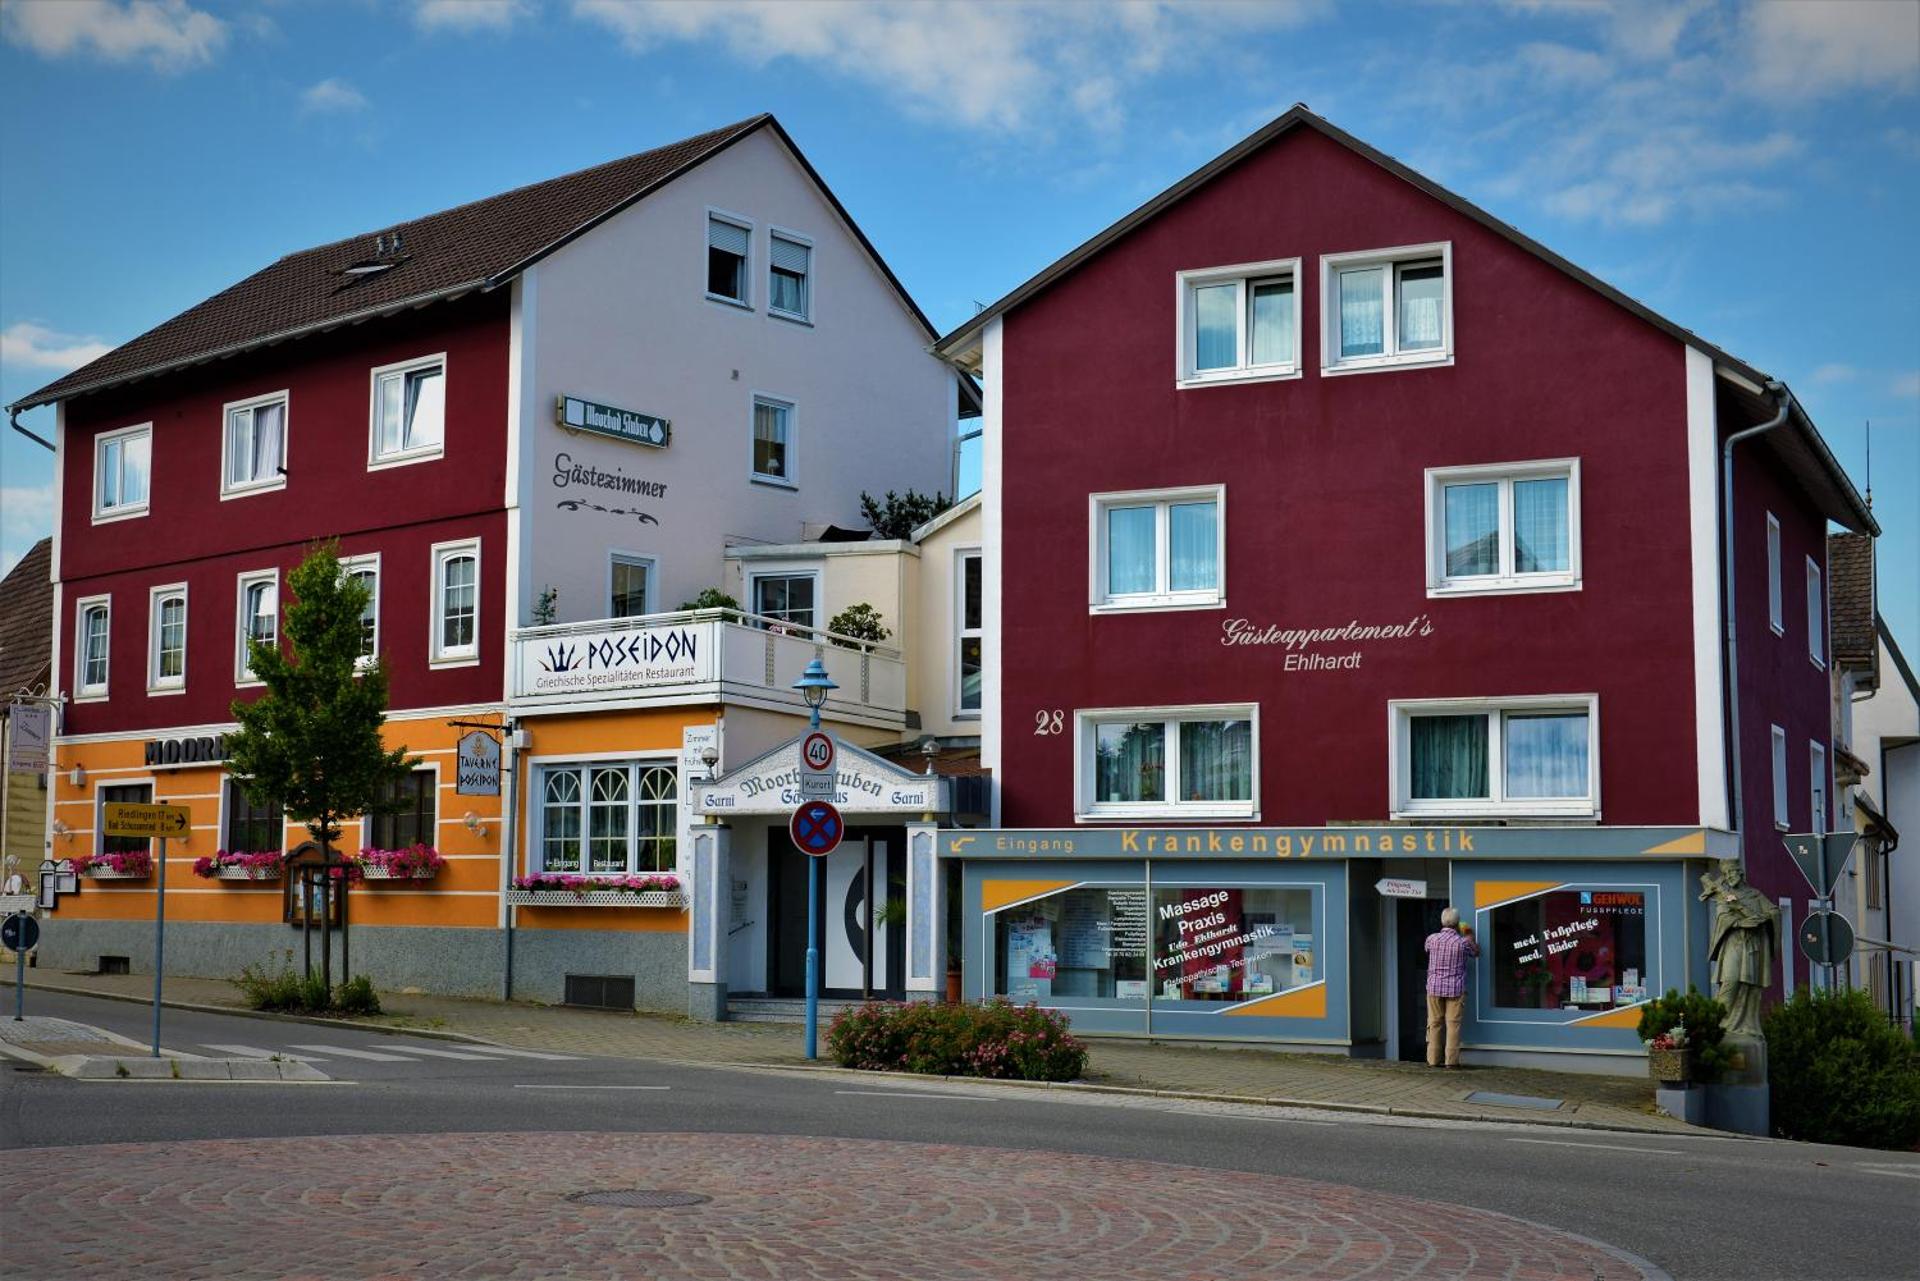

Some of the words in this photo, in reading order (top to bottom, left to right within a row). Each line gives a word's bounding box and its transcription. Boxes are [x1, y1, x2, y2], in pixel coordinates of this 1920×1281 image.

[622, 413, 649, 439] Stuben
[553, 453, 667, 499] Gästezimmer
[1221, 614, 1434, 650] Gästeappartement's
[1284, 652, 1362, 672] Ehlhardt
[536, 672, 585, 689] Griechische
[587, 669, 644, 688] Spezialitäten
[646, 666, 696, 680] Restaurant
[1034, 709, 1065, 736] 28
[809, 743, 828, 761] 40
[805, 780, 831, 791] Kurort
[705, 793, 735, 807] Garni
[891, 791, 924, 805] Garni
[996, 837, 1074, 853] Eingang
[1121, 830, 1475, 858] Krankengymnastik
[553, 858, 579, 868] Eingang
[593, 859, 625, 868] Restaurant
[1159, 890, 1229, 920] Massage
[1580, 906, 1643, 915] FUSSPFLEGE
[1177, 911, 1226, 935] Praxis
[1194, 924, 1239, 945] Ehlhardt
[1513, 934, 1540, 950] med.
[1543, 918, 1599, 941] Fußpflege
[1152, 925, 1275, 971] Krankengymnastik
[1518, 949, 1543, 965] med.
[1547, 939, 1580, 955] Bäder
